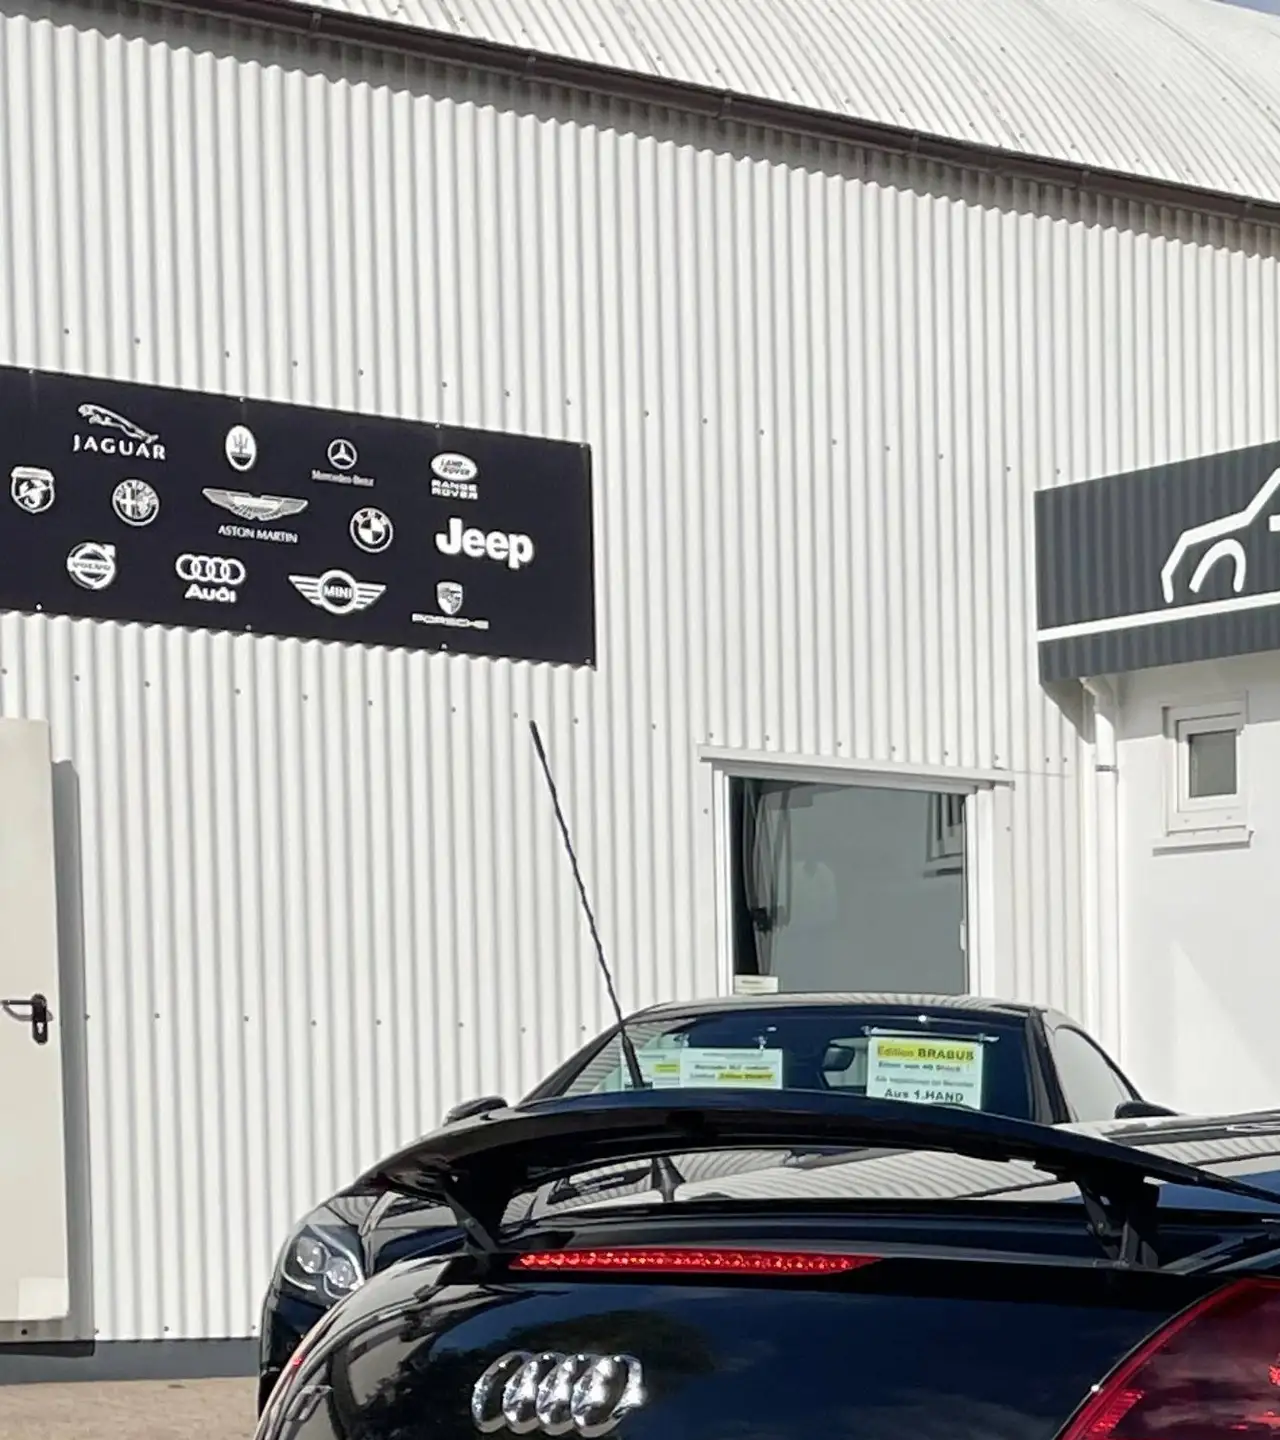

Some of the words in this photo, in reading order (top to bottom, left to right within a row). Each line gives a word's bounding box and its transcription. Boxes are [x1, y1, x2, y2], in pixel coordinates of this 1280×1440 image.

[73, 434, 166, 460] JAGUAR
[218, 525, 254, 539] ASTON
[256, 529, 298, 543] MARTIN
[435, 517, 534, 569] Jeep
[184, 583, 236, 602] Audi
[324, 585, 352, 599] MINI
